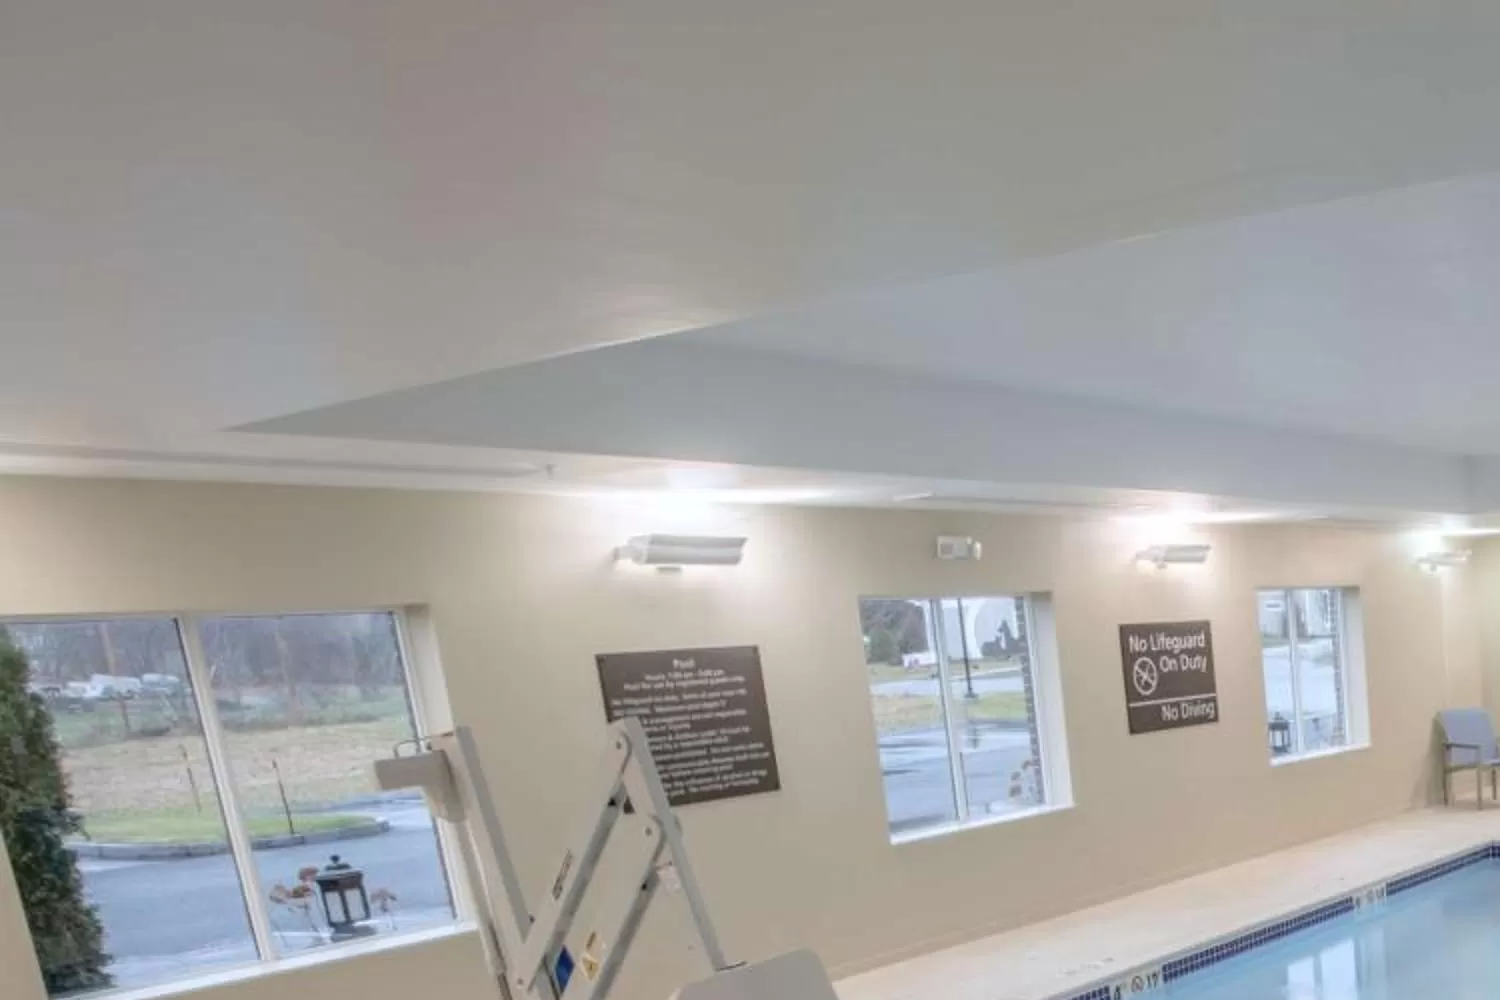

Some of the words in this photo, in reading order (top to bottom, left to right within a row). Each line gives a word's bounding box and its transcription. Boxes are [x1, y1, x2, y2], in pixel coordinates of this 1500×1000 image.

[1129, 635, 1147, 652] No
[1150, 631, 1205, 654] Lifeguard
[1160, 655, 1178, 672] On
[1180, 653, 1207, 673] Duty
[1162, 703, 1179, 721] No
[1181, 701, 1215, 720] Diving
